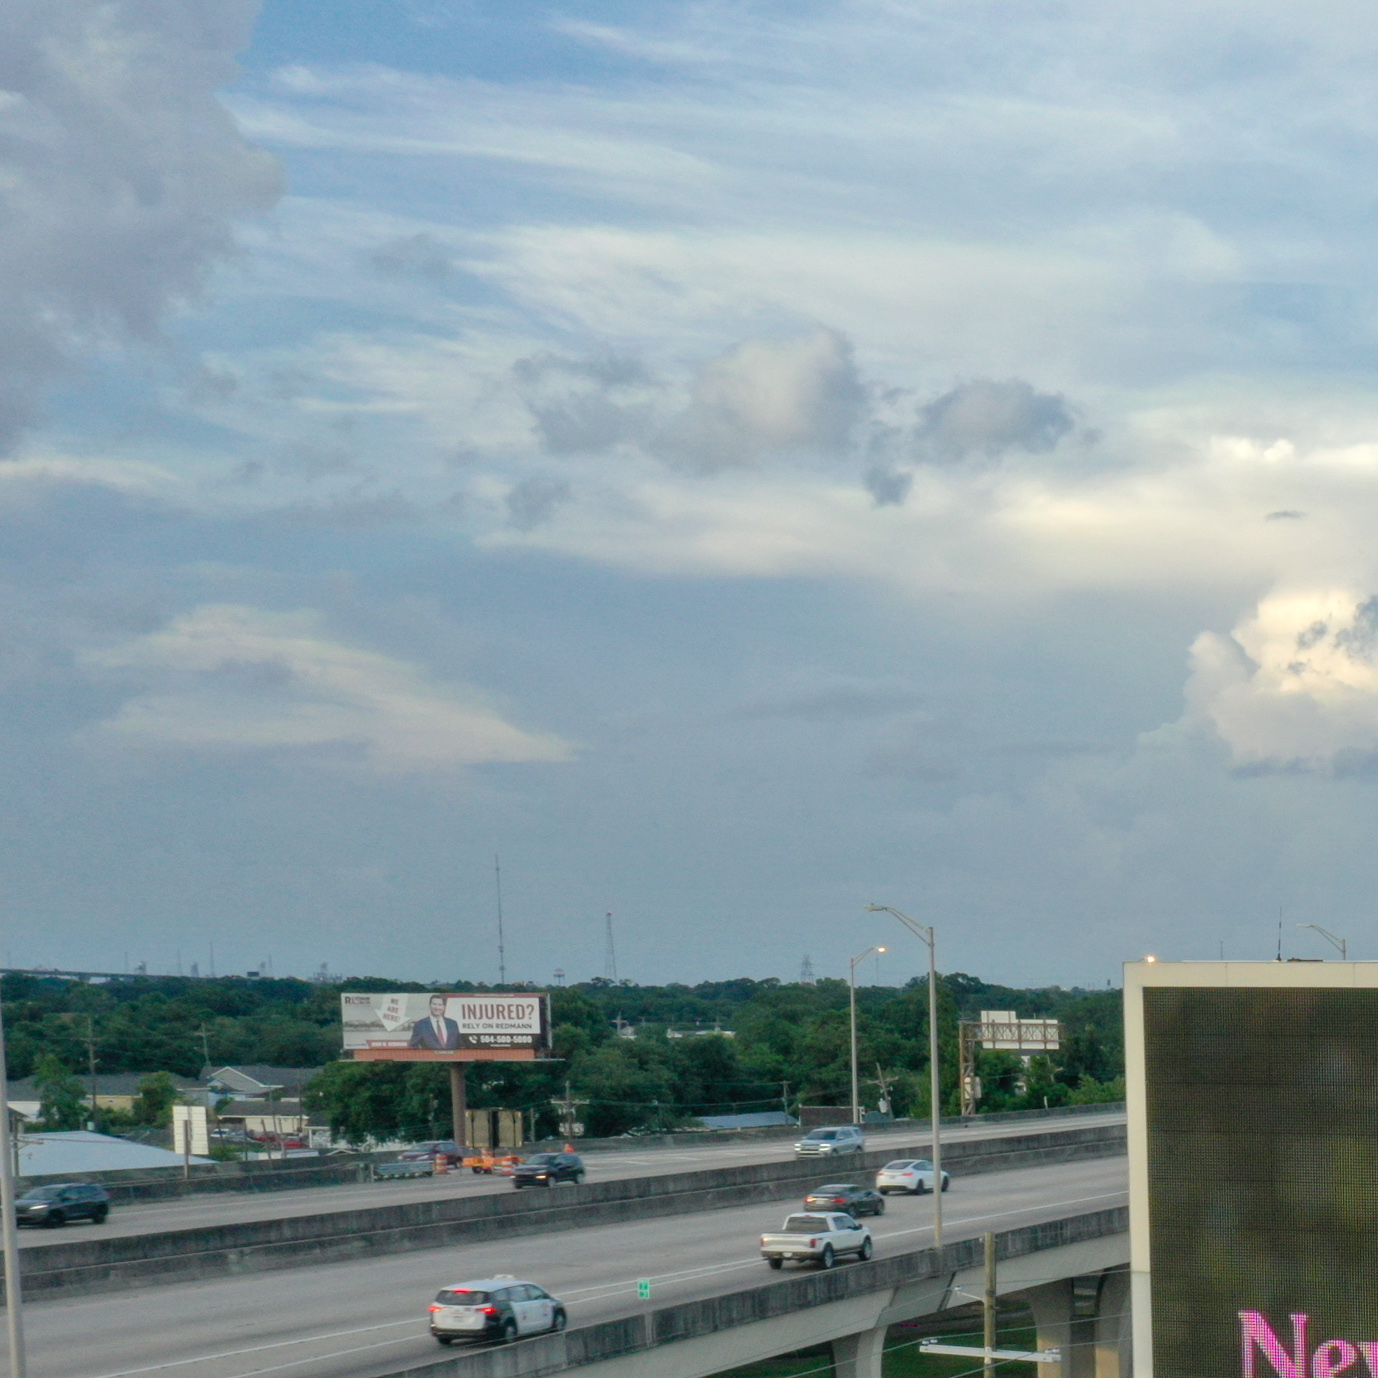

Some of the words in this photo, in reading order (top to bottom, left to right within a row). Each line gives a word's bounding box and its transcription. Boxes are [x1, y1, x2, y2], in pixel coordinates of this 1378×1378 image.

[462, 1004, 535, 1020] INJURED?
[482, 1022, 494, 1030] ON
[496, 1022, 533, 1030] REDMANN
